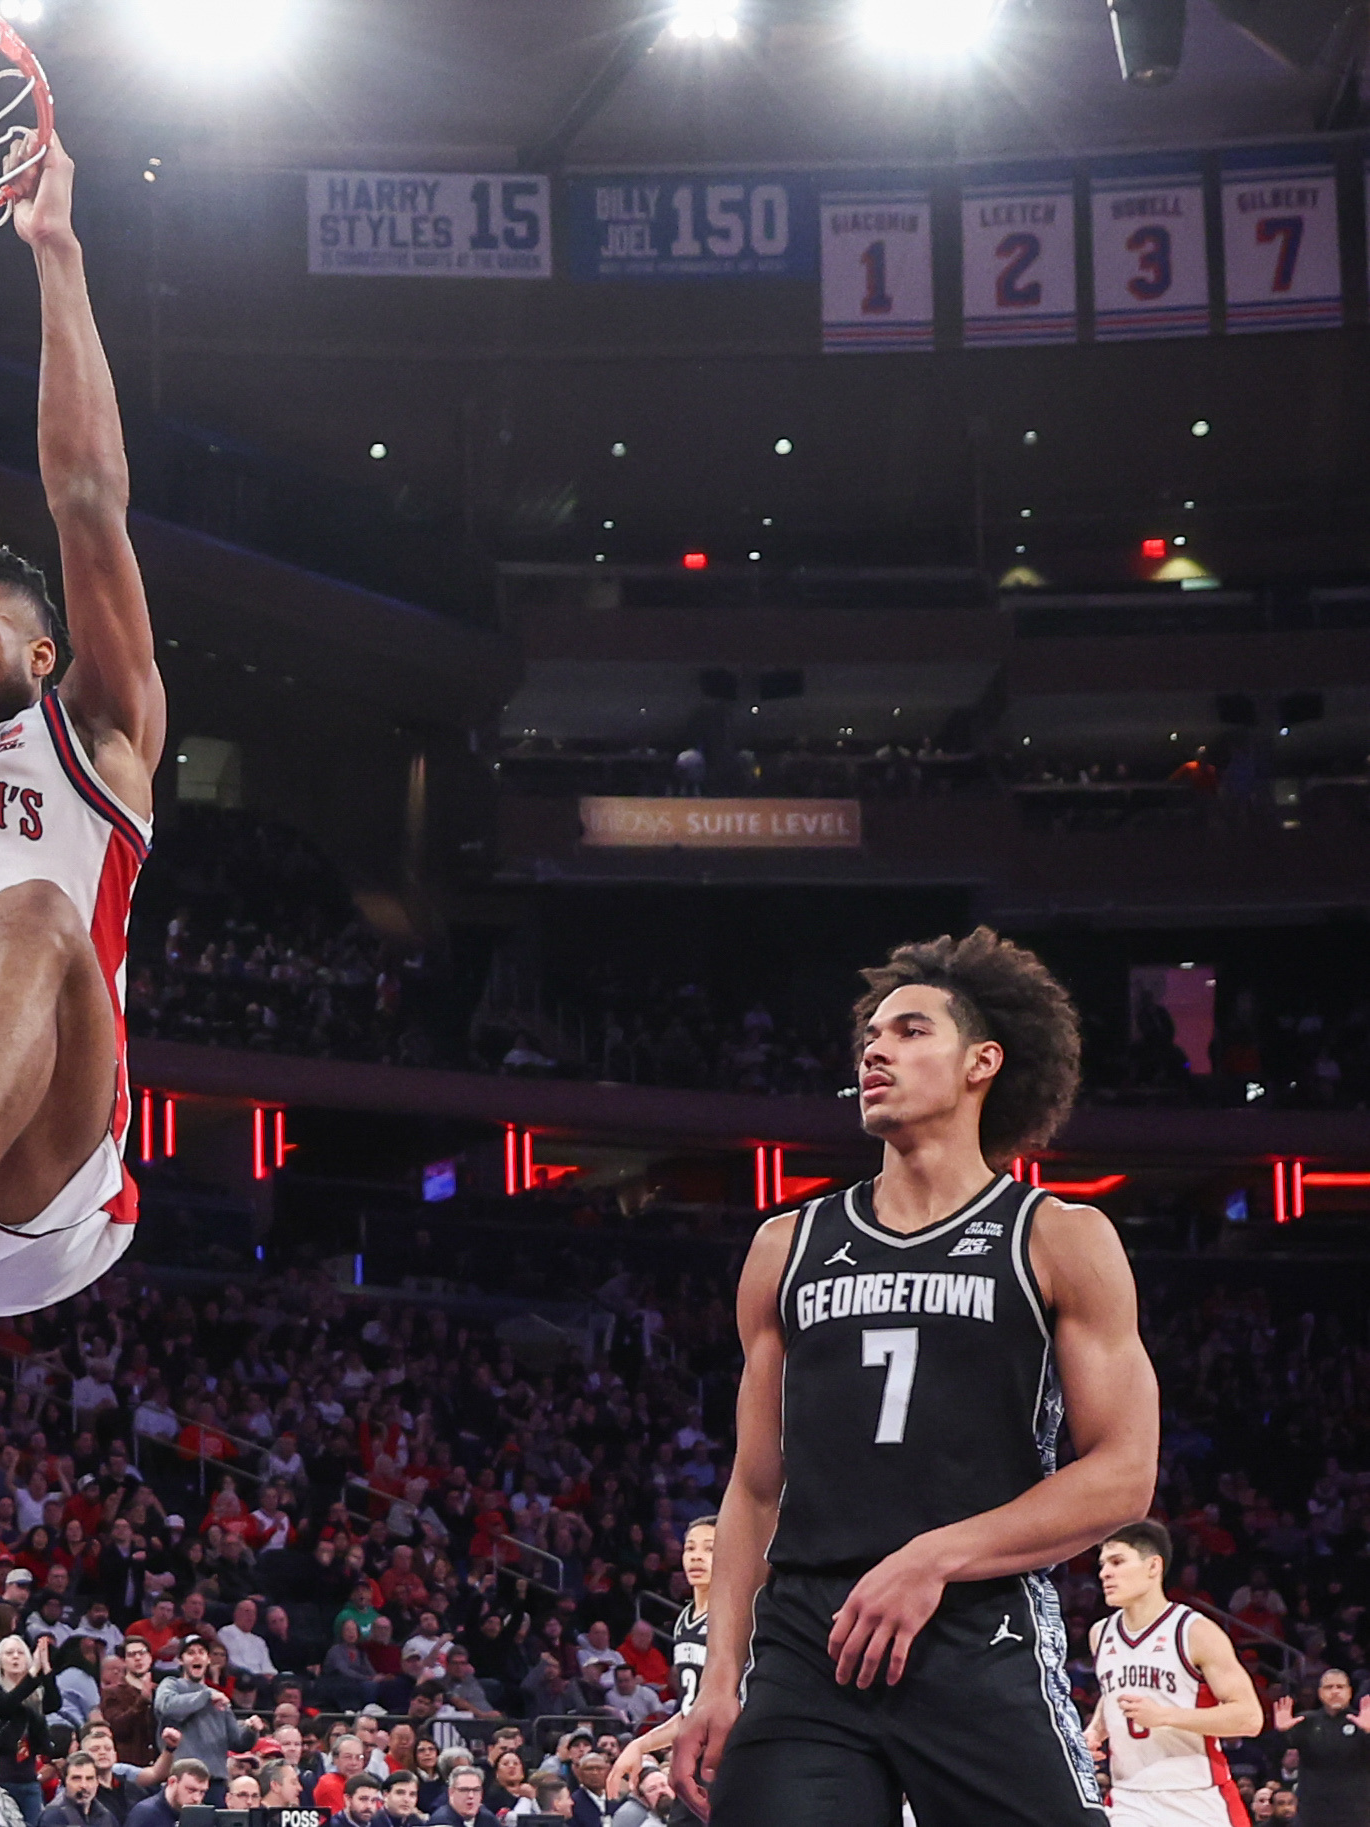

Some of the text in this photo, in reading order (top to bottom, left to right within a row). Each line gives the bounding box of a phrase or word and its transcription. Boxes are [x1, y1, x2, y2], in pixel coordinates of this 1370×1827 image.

[328, 178, 440, 213] HARRY
[469, 181, 541, 250] 15
[596, 185, 661, 220] BILLY
[671, 184, 790, 257] 150
[319, 214, 454, 248] STYLES
[601, 223, 658, 257] JOEL
[1255, 215, 1304, 292] 7
[860, 240, 894, 314] 1
[995, 232, 1042, 307] 2
[1125, 225, 1172, 300] 3
[686, 812, 762, 835] SUITE
[770, 812, 850, 836] LEVEL
[796, 1272, 996, 1331] GEORGETOWN
[861, 1327, 919, 1444] 7
[1117, 1665, 1177, 1694] JOHN'S
[281, 1810, 319, 1827] POSS
